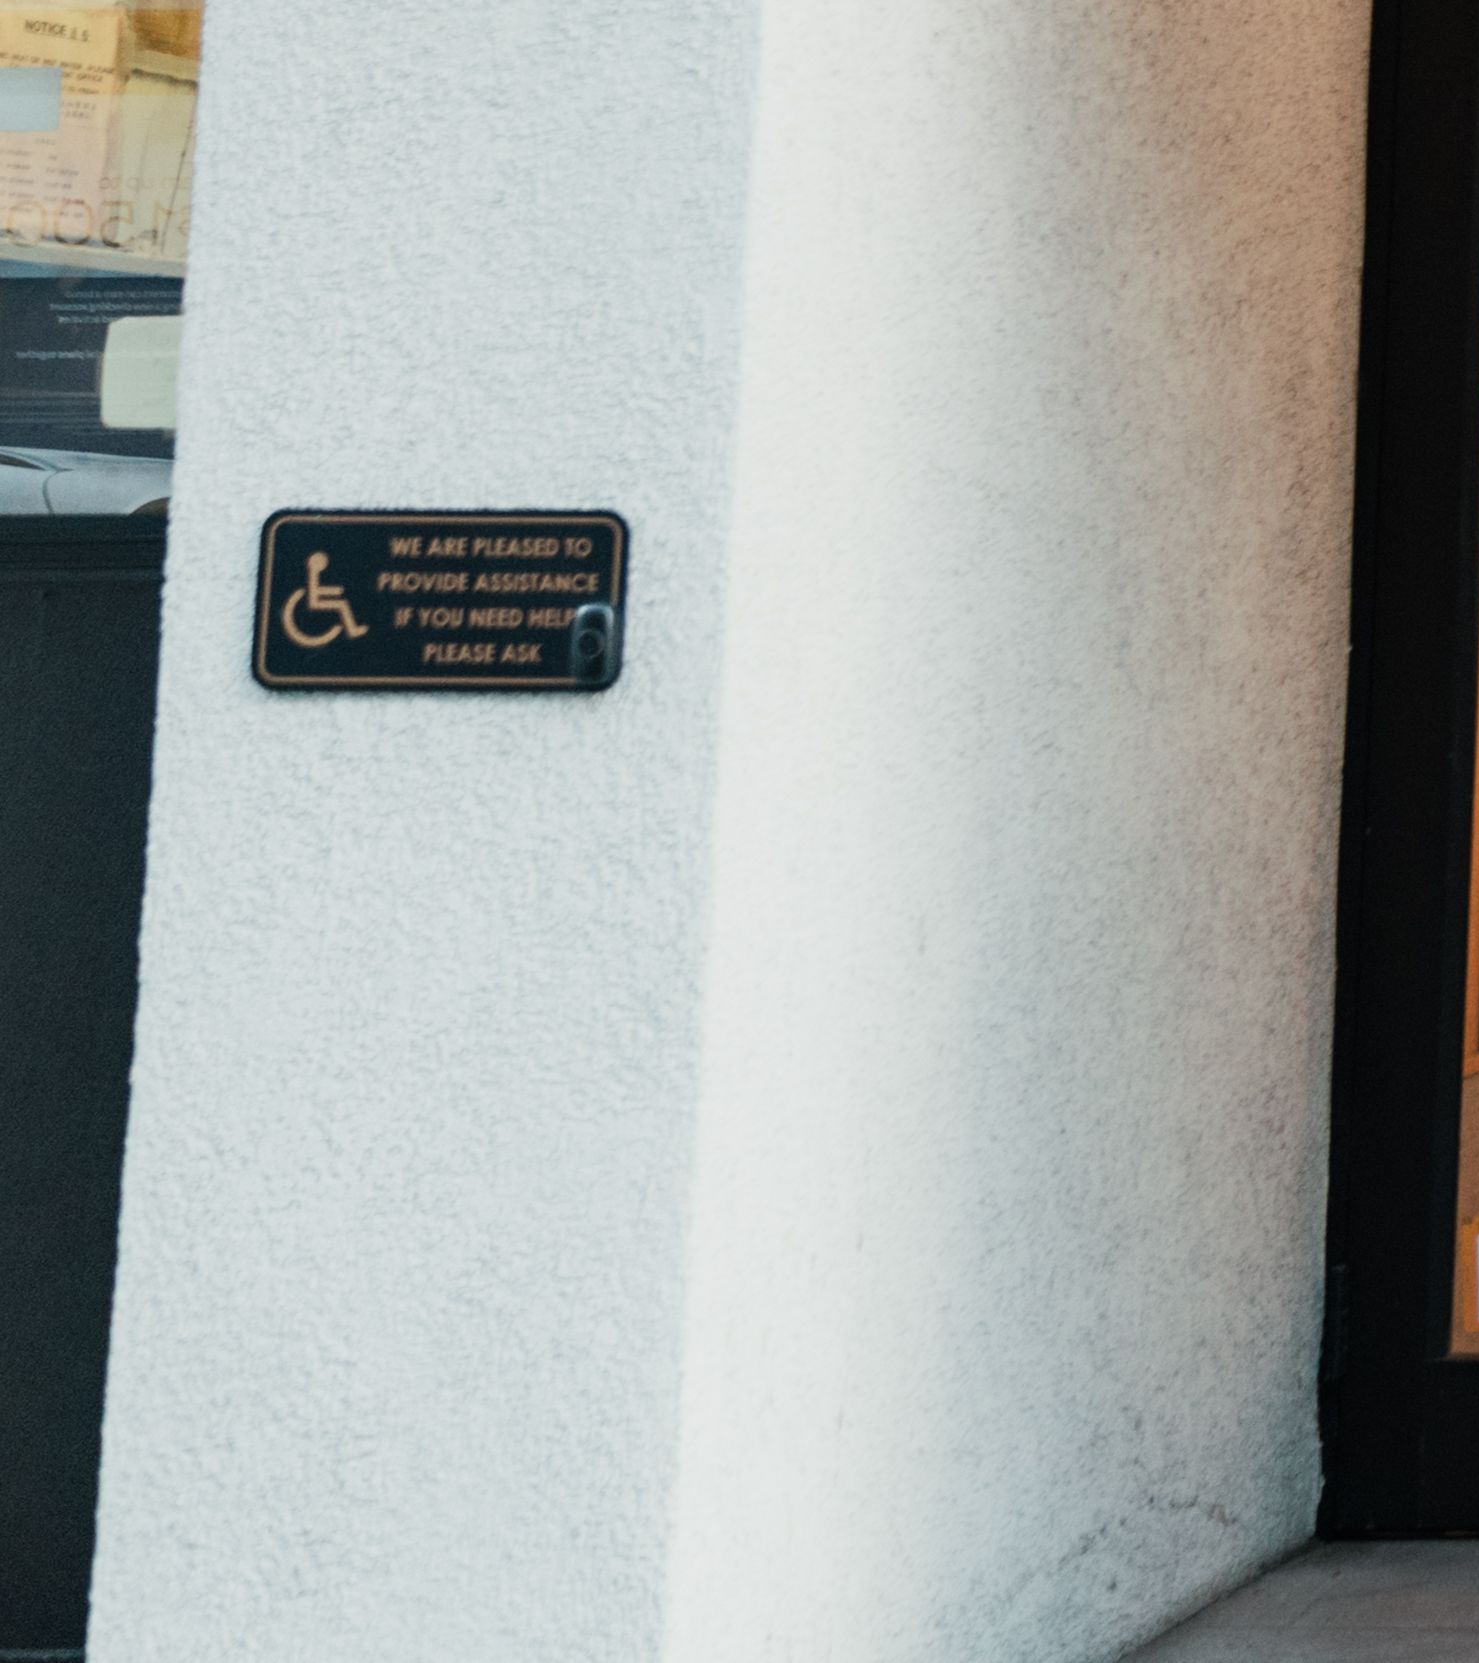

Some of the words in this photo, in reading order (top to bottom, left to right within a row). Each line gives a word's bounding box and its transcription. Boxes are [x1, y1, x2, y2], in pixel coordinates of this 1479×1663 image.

[390, 537, 422, 557] WE
[427, 537, 468, 557] ARE
[472, 538, 560, 558] PLEASED
[564, 537, 593, 558] TO
[376, 572, 470, 592] PROVIDE
[473, 572, 599, 593] ASSISTANCE
[394, 607, 414, 627] IF
[418, 607, 465, 628] YOU
[468, 607, 524, 628] NEED
[527, 607, 578, 628] HELP
[422, 642, 496, 664] PLEASE
[500, 643, 543, 663] ASK
